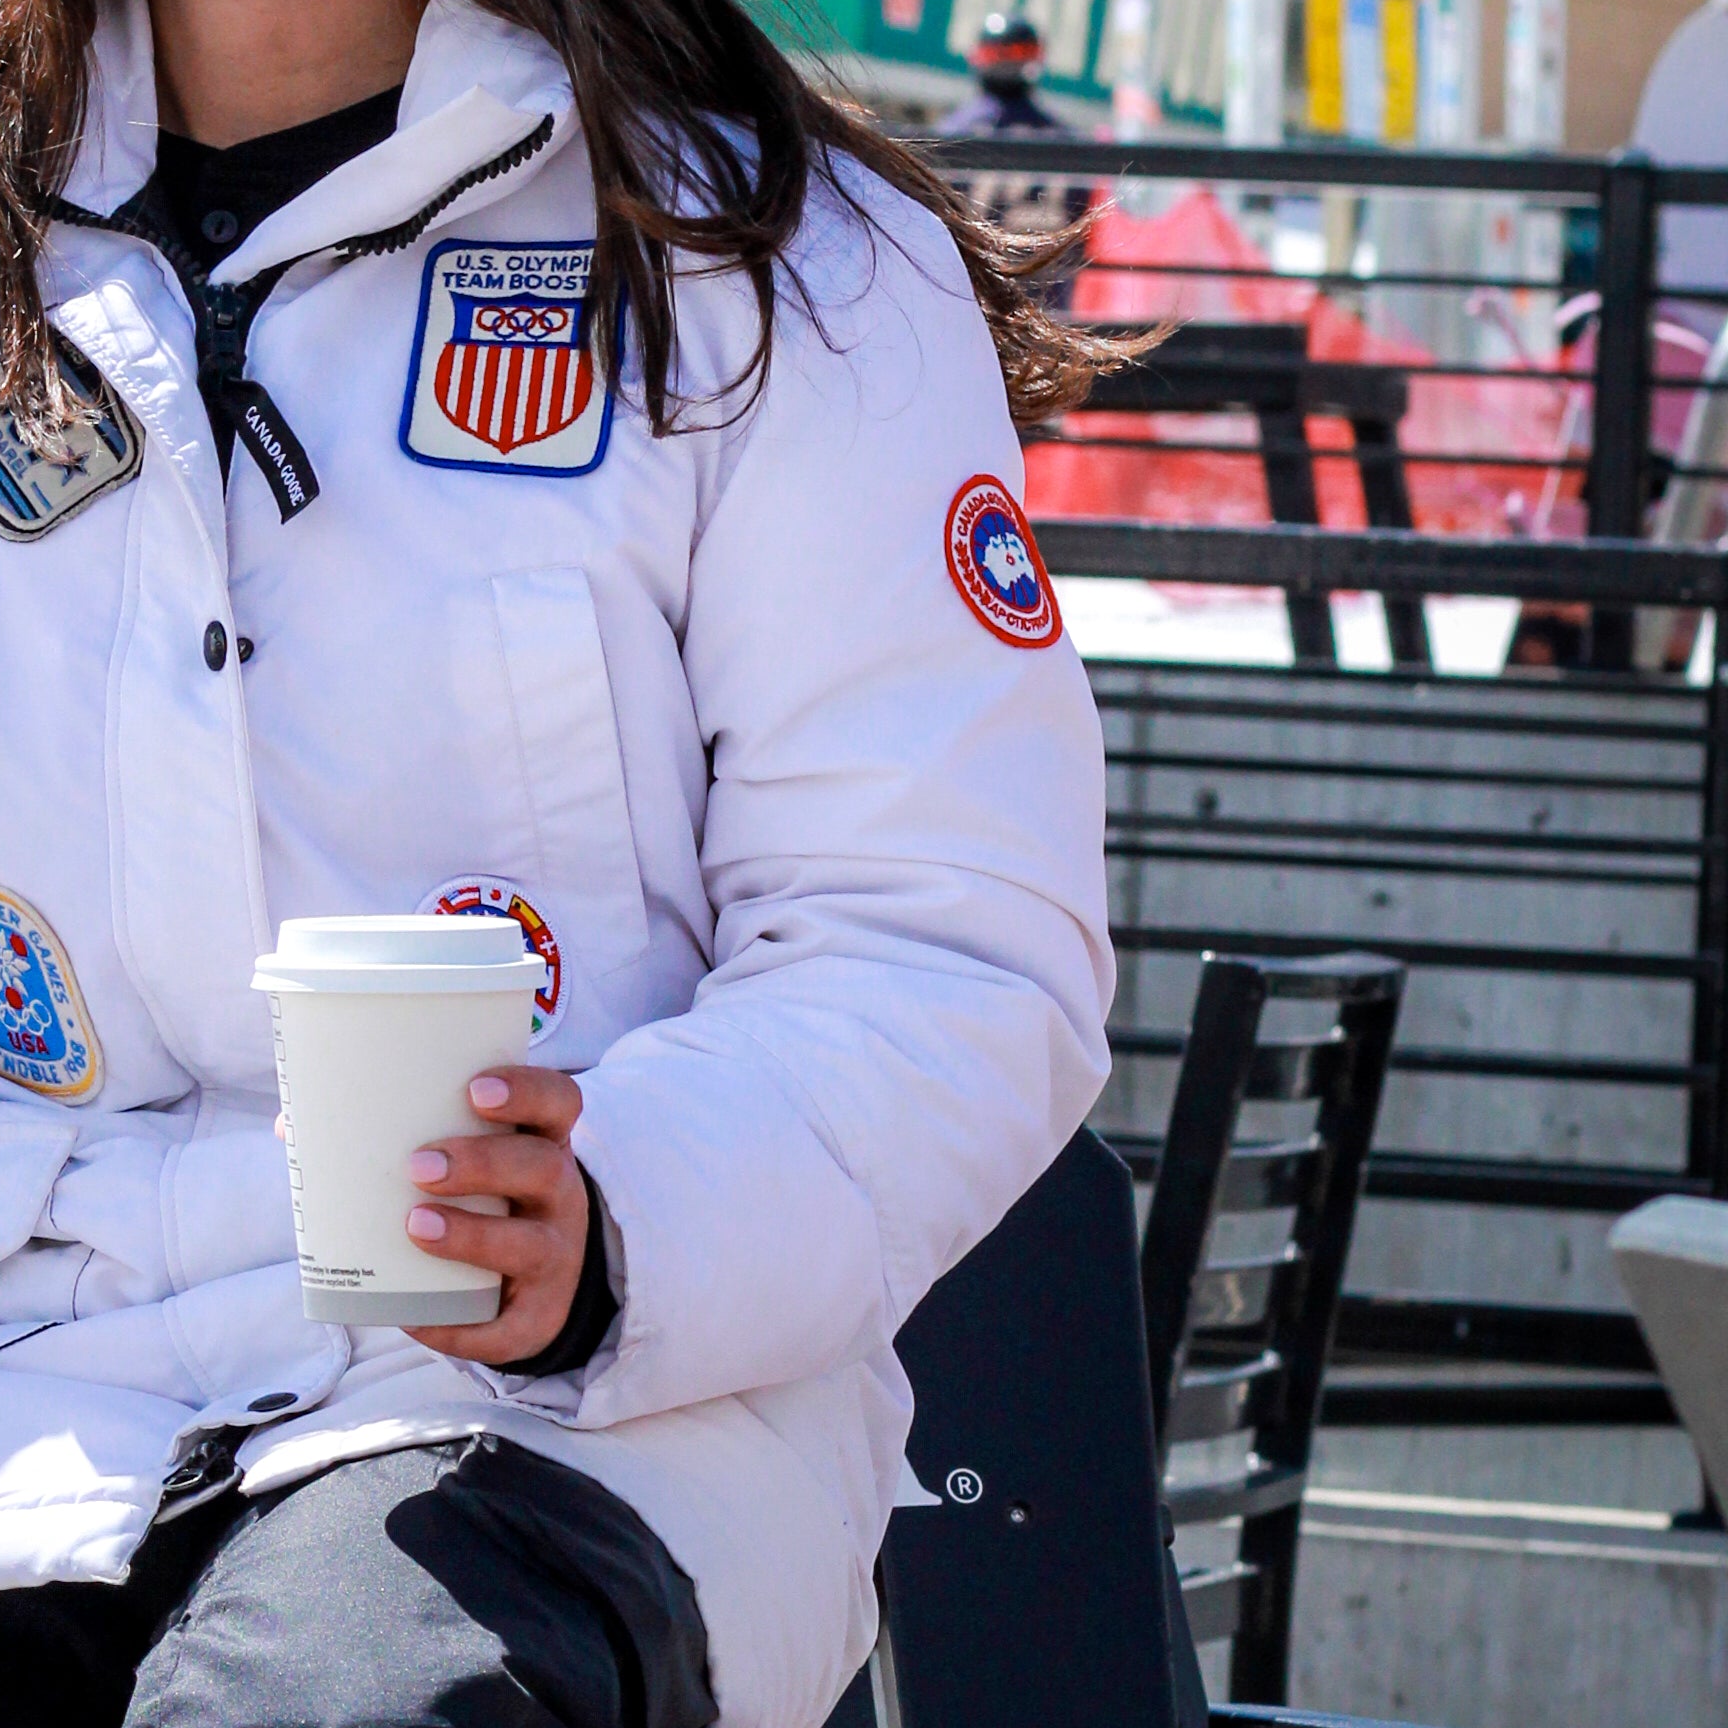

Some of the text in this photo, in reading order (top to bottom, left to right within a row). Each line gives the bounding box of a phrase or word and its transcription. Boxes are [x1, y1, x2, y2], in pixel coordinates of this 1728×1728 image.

[456, 255, 589, 271] U.S. OLYMPI
[442, 273, 589, 290] TEAM BOOST
[245, 406, 306, 507] CANADA GOOSE
[957, 492, 988, 536] CANADA
[28, 929, 70, 1005] GAMES
[7, 1031, 50, 1055] USA
